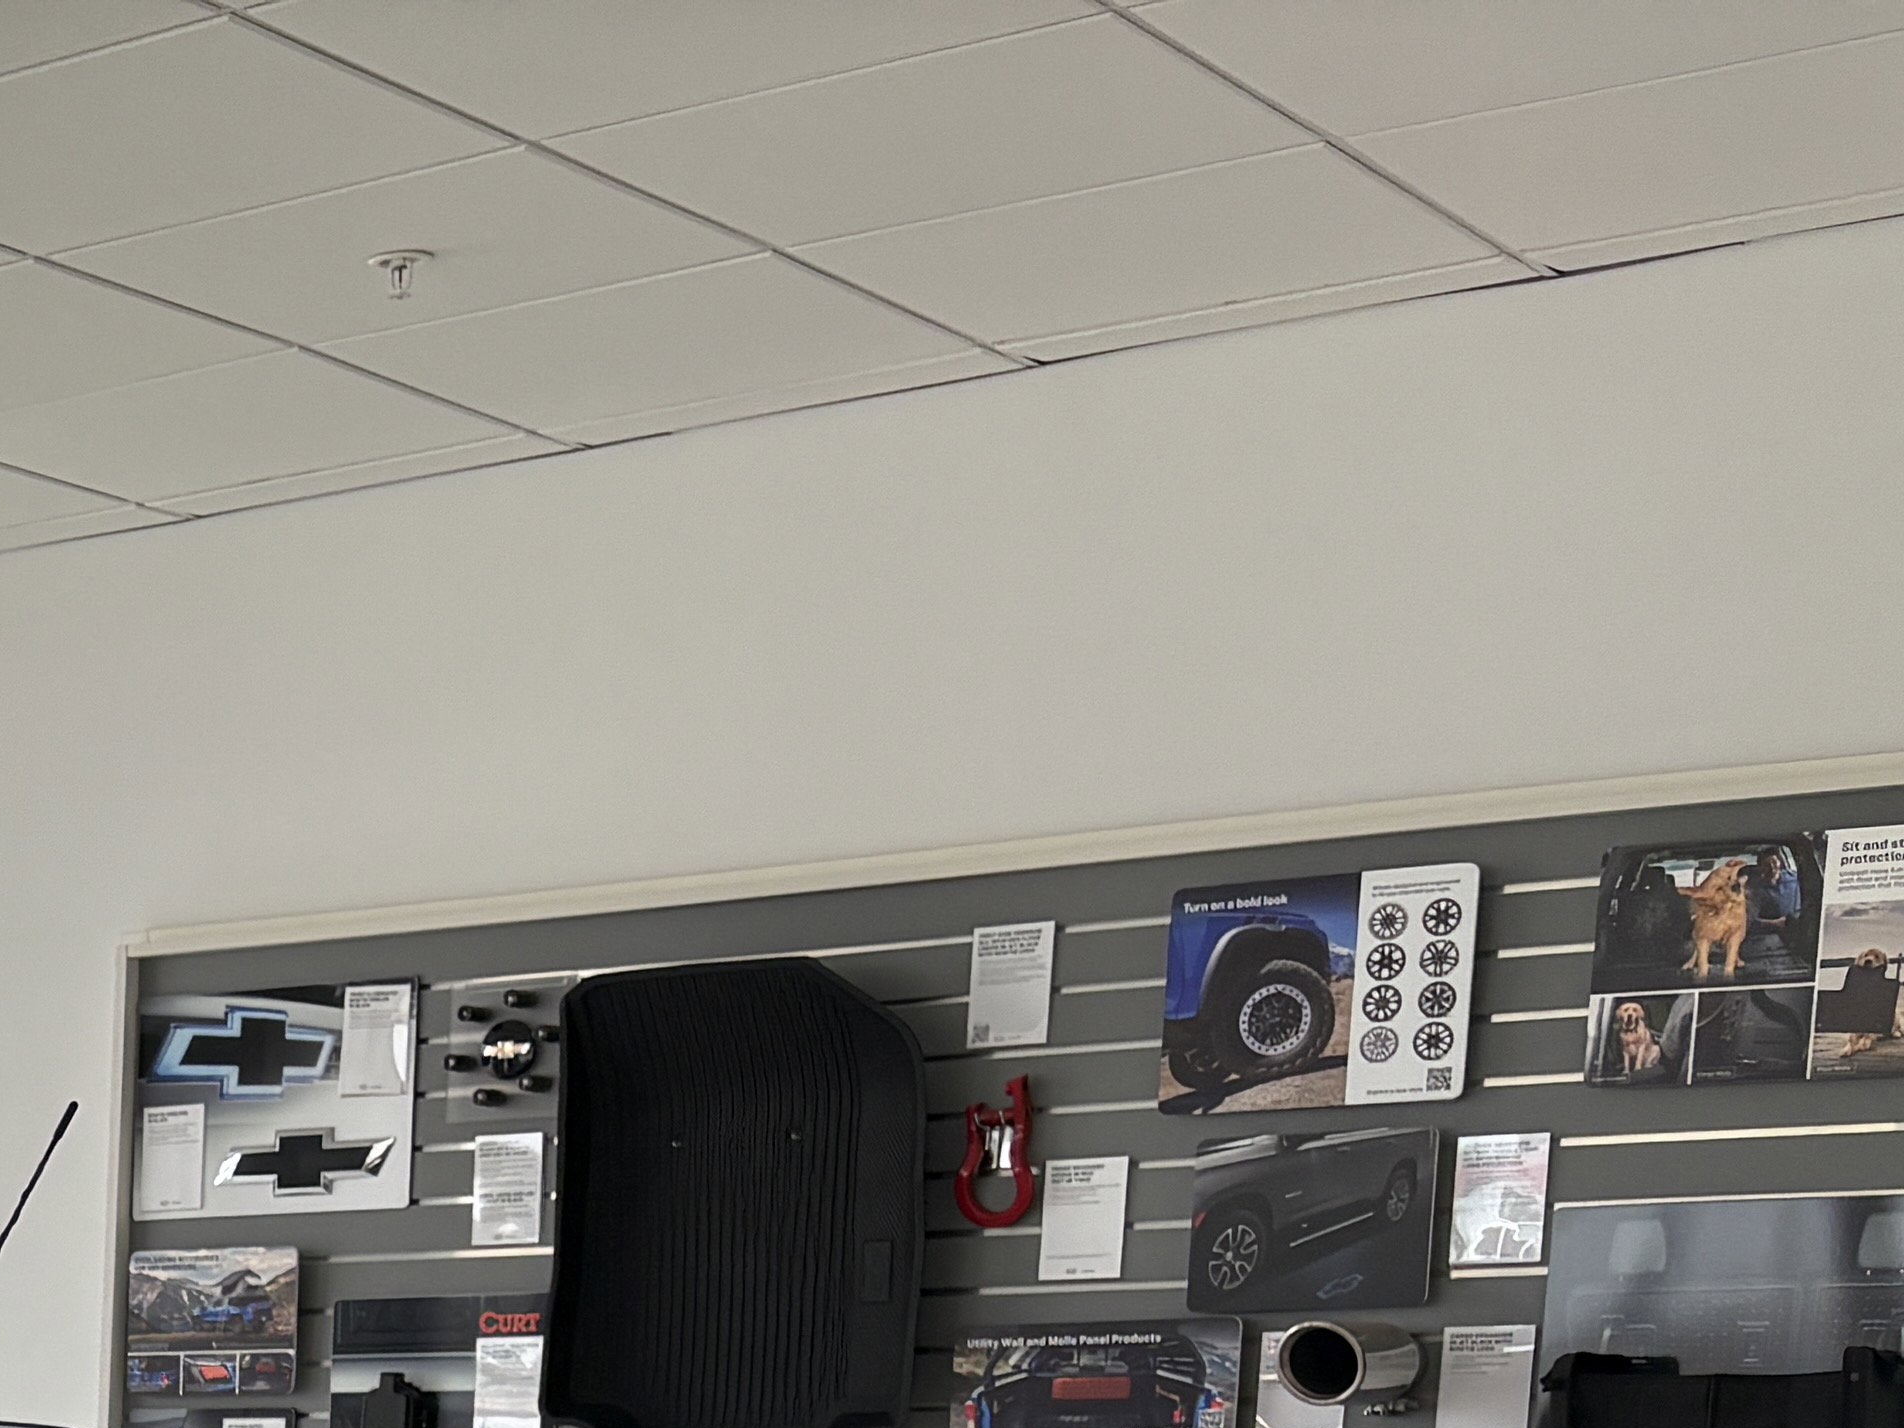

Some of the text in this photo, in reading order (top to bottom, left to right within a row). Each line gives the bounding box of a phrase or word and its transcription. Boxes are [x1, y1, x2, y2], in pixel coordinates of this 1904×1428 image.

[1842, 841, 1860, 852] Sit
[1863, 839, 1888, 850] and
[1840, 852, 1904, 867] protectio
[1184, 894, 1288, 914] Turn on a bold look
[480, 1311, 541, 1334] CURT
[967, 1337, 998, 1350] Utility
[1000, 1337, 1024, 1348] Wall
[1026, 1336, 1046, 1347] and
[1079, 1334, 1110, 1346] Panel
[1111, 1333, 1162, 1345] Products
